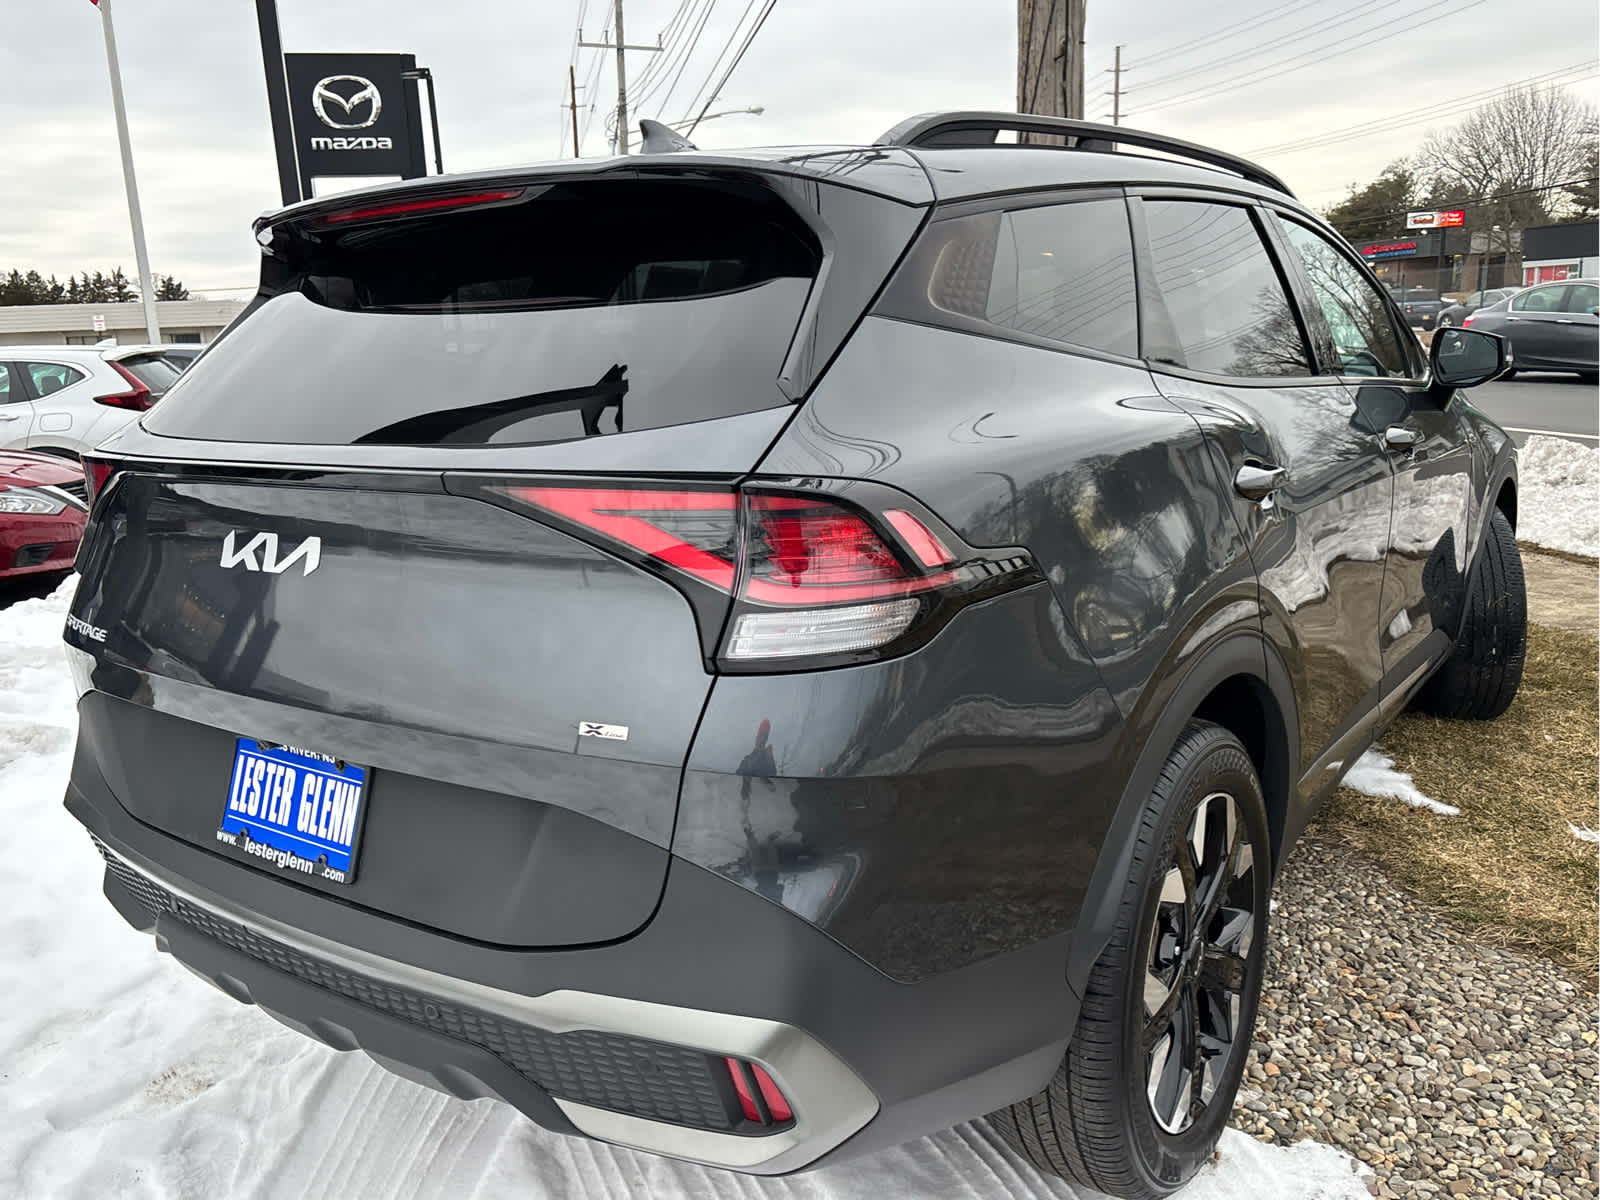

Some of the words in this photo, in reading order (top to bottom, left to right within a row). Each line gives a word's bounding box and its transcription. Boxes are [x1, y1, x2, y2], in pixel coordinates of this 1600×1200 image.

[220, 529, 321, 577] KIA
[230, 754, 296, 827] LESTER
[296, 772, 361, 847] GLENN
